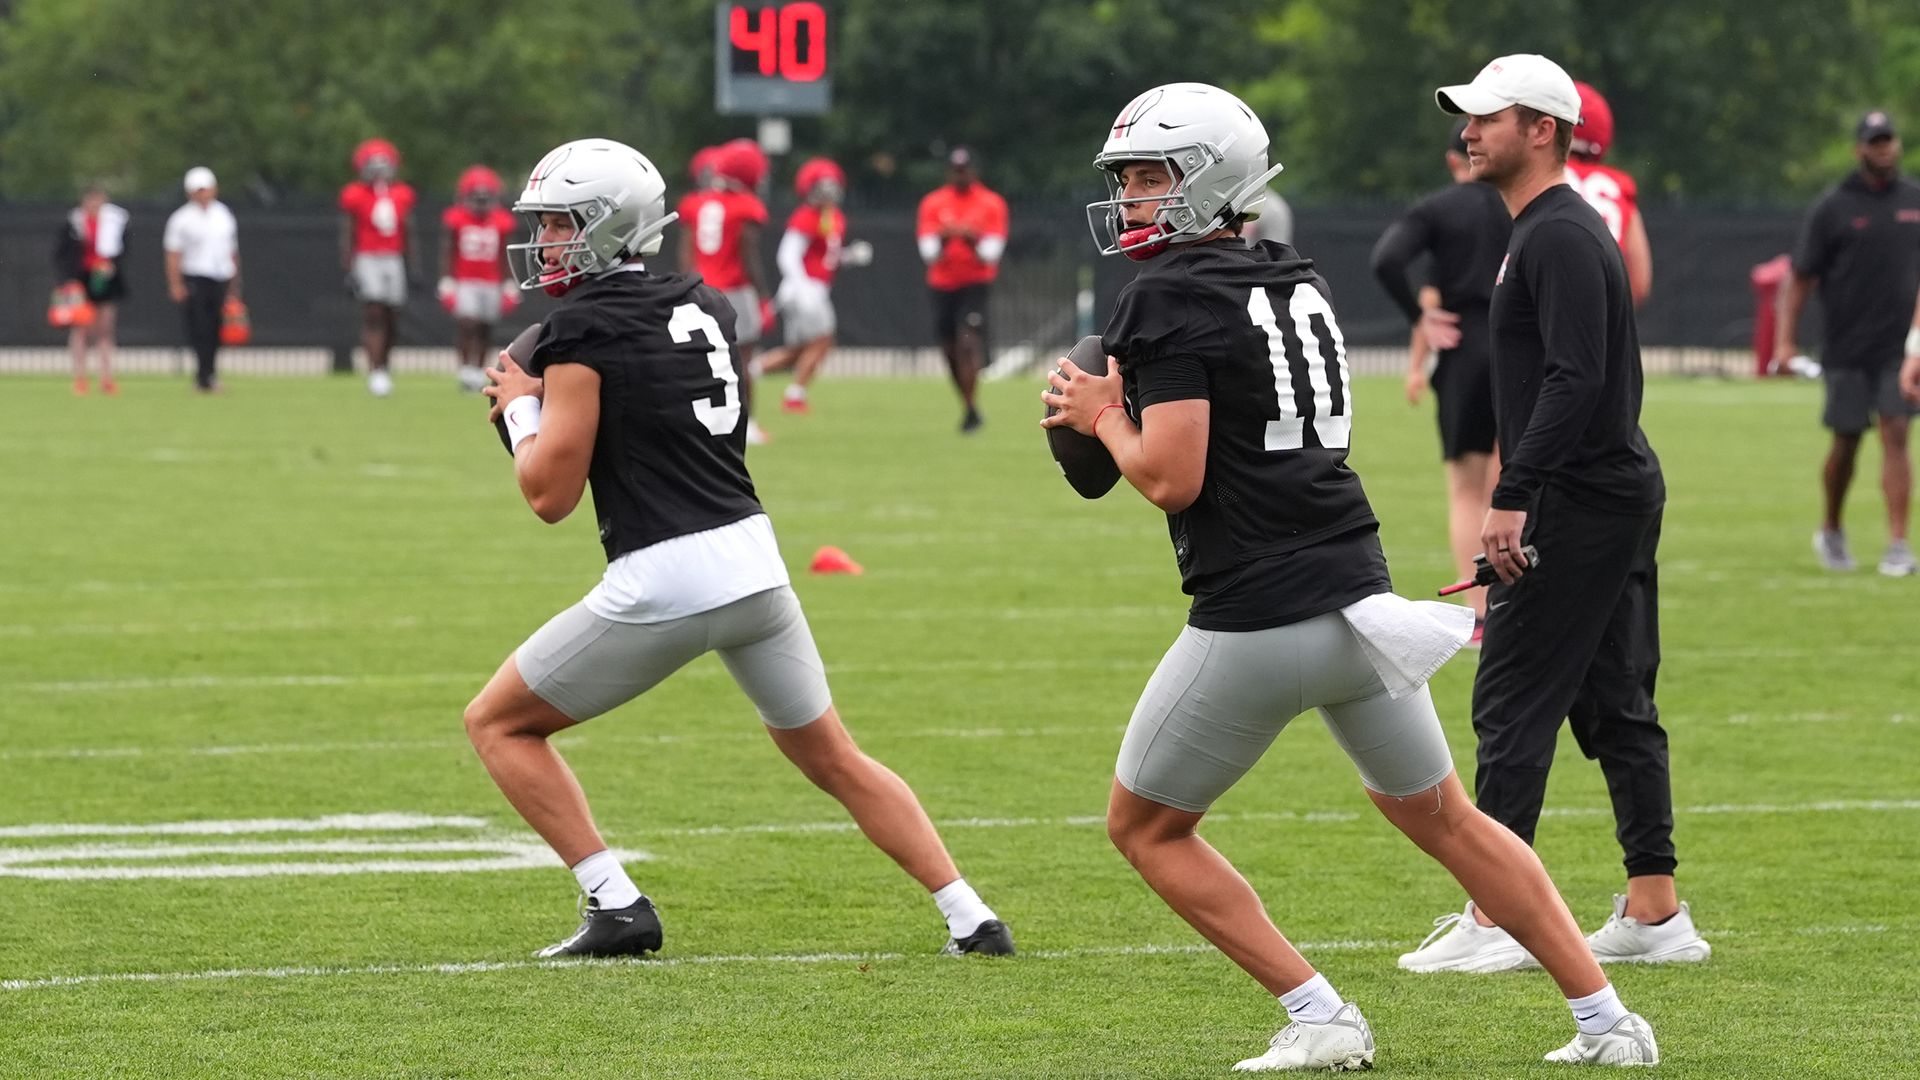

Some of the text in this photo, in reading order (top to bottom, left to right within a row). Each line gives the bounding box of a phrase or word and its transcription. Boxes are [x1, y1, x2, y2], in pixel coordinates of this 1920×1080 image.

[730, 2, 826, 82] 40
[371, 197, 398, 238] 4
[1564, 166, 1622, 242] 6
[667, 302, 741, 436] 3
[1247, 282, 1352, 451] 10
